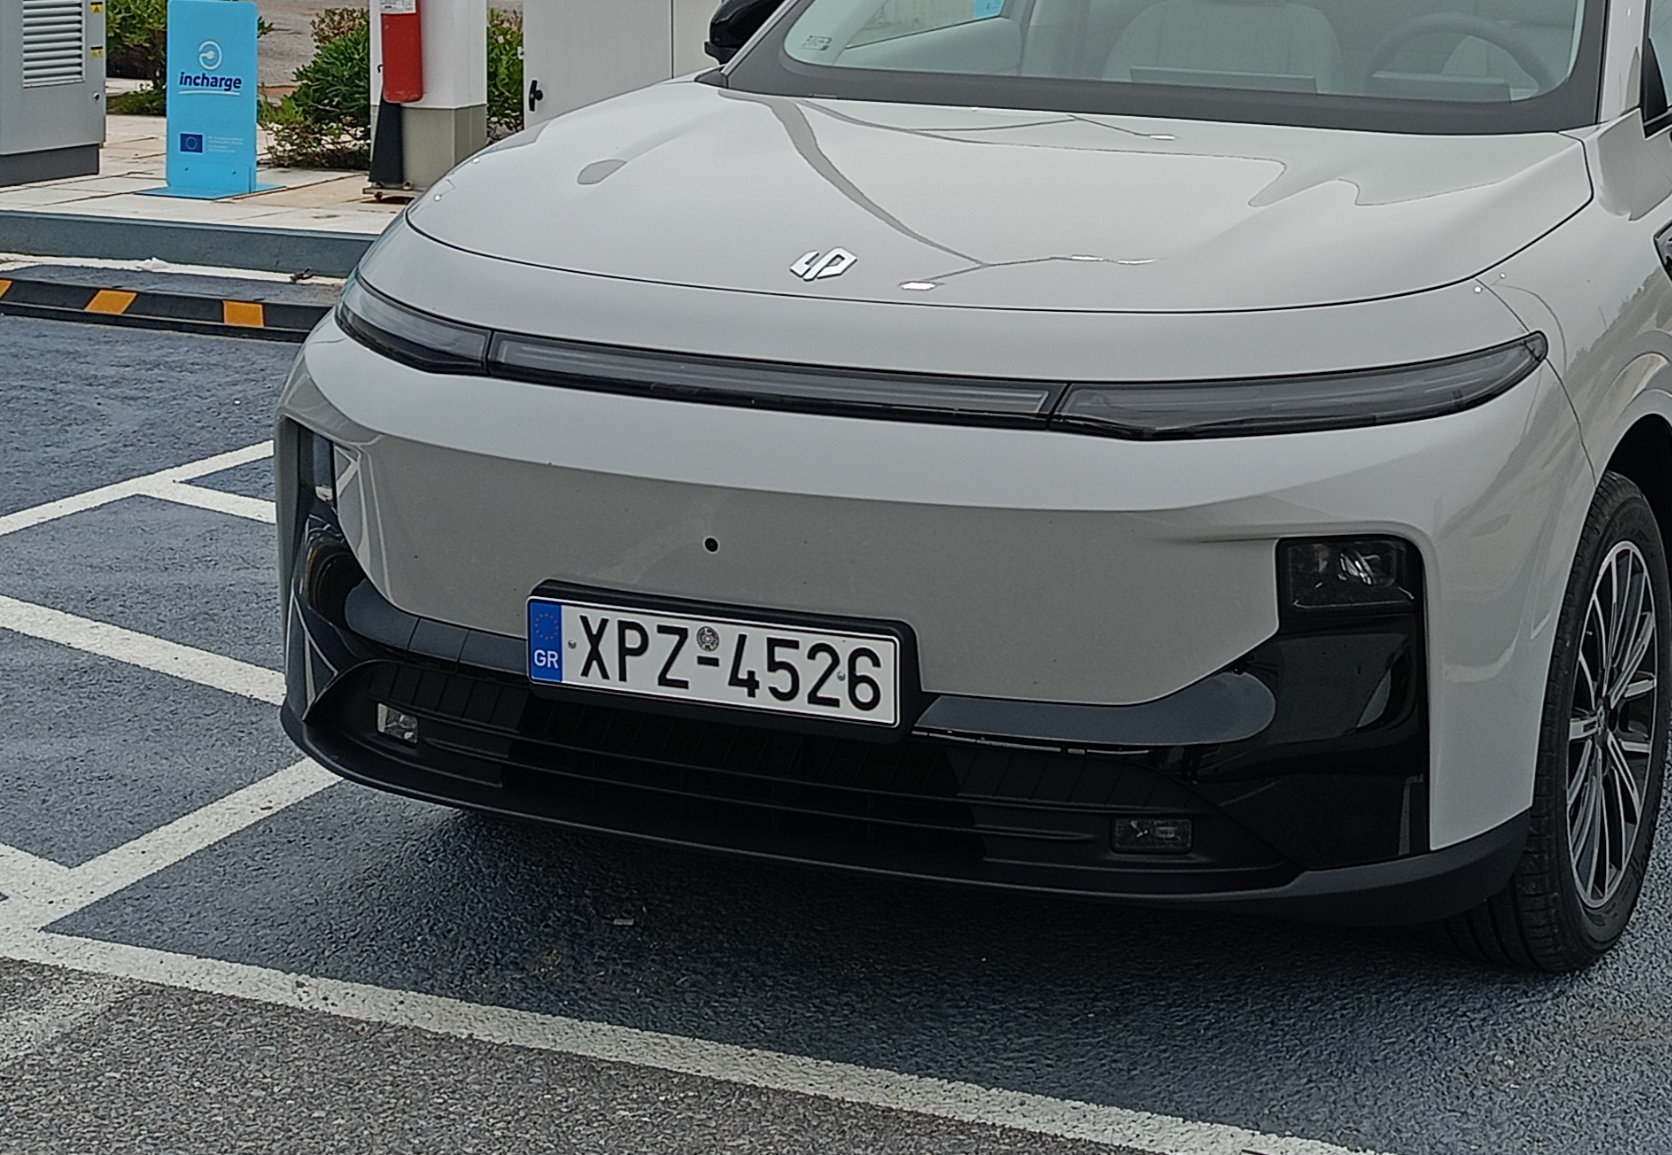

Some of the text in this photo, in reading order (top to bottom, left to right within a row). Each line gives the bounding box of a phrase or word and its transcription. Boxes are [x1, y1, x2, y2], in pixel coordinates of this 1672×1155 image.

[179, 71, 243, 91] incharge
[533, 649, 559, 669] GR
[578, 614, 882, 712] XPZ-4526
